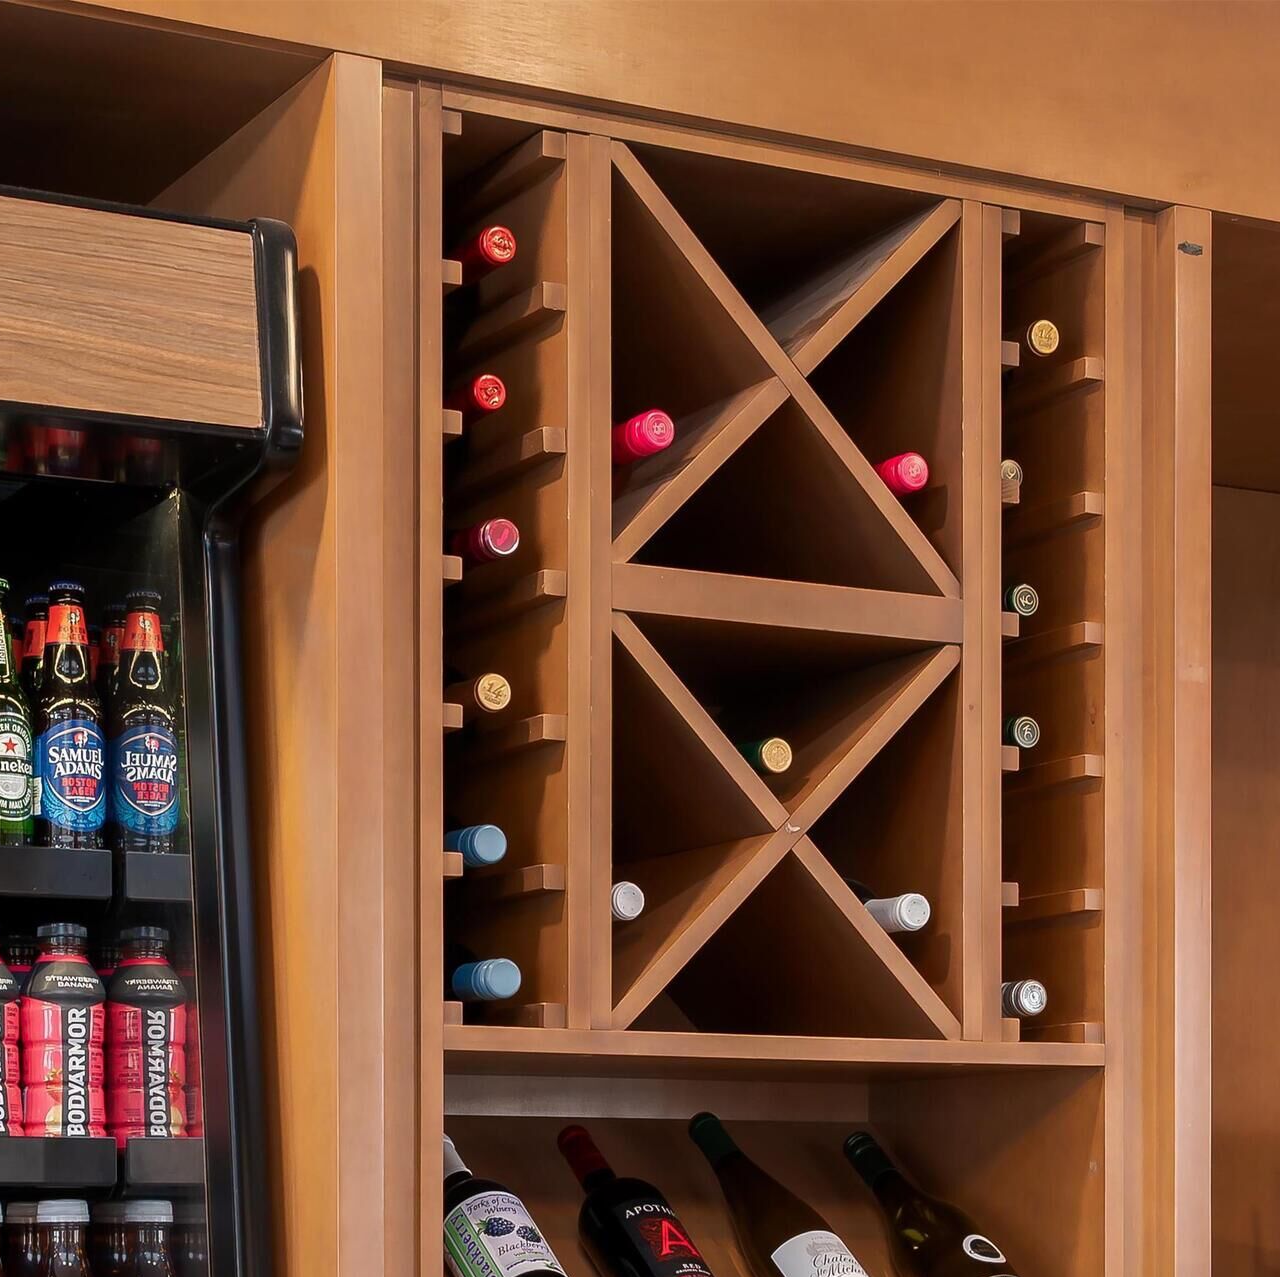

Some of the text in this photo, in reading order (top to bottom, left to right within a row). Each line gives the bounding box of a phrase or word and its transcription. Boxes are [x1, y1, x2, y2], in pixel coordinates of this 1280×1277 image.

[48, 746, 104, 766] SAMUEL
[54, 764, 102, 779] ADAMS
[67, 1007, 87, 1136] BODYARMOR
[660, 1220, 699, 1256] A
